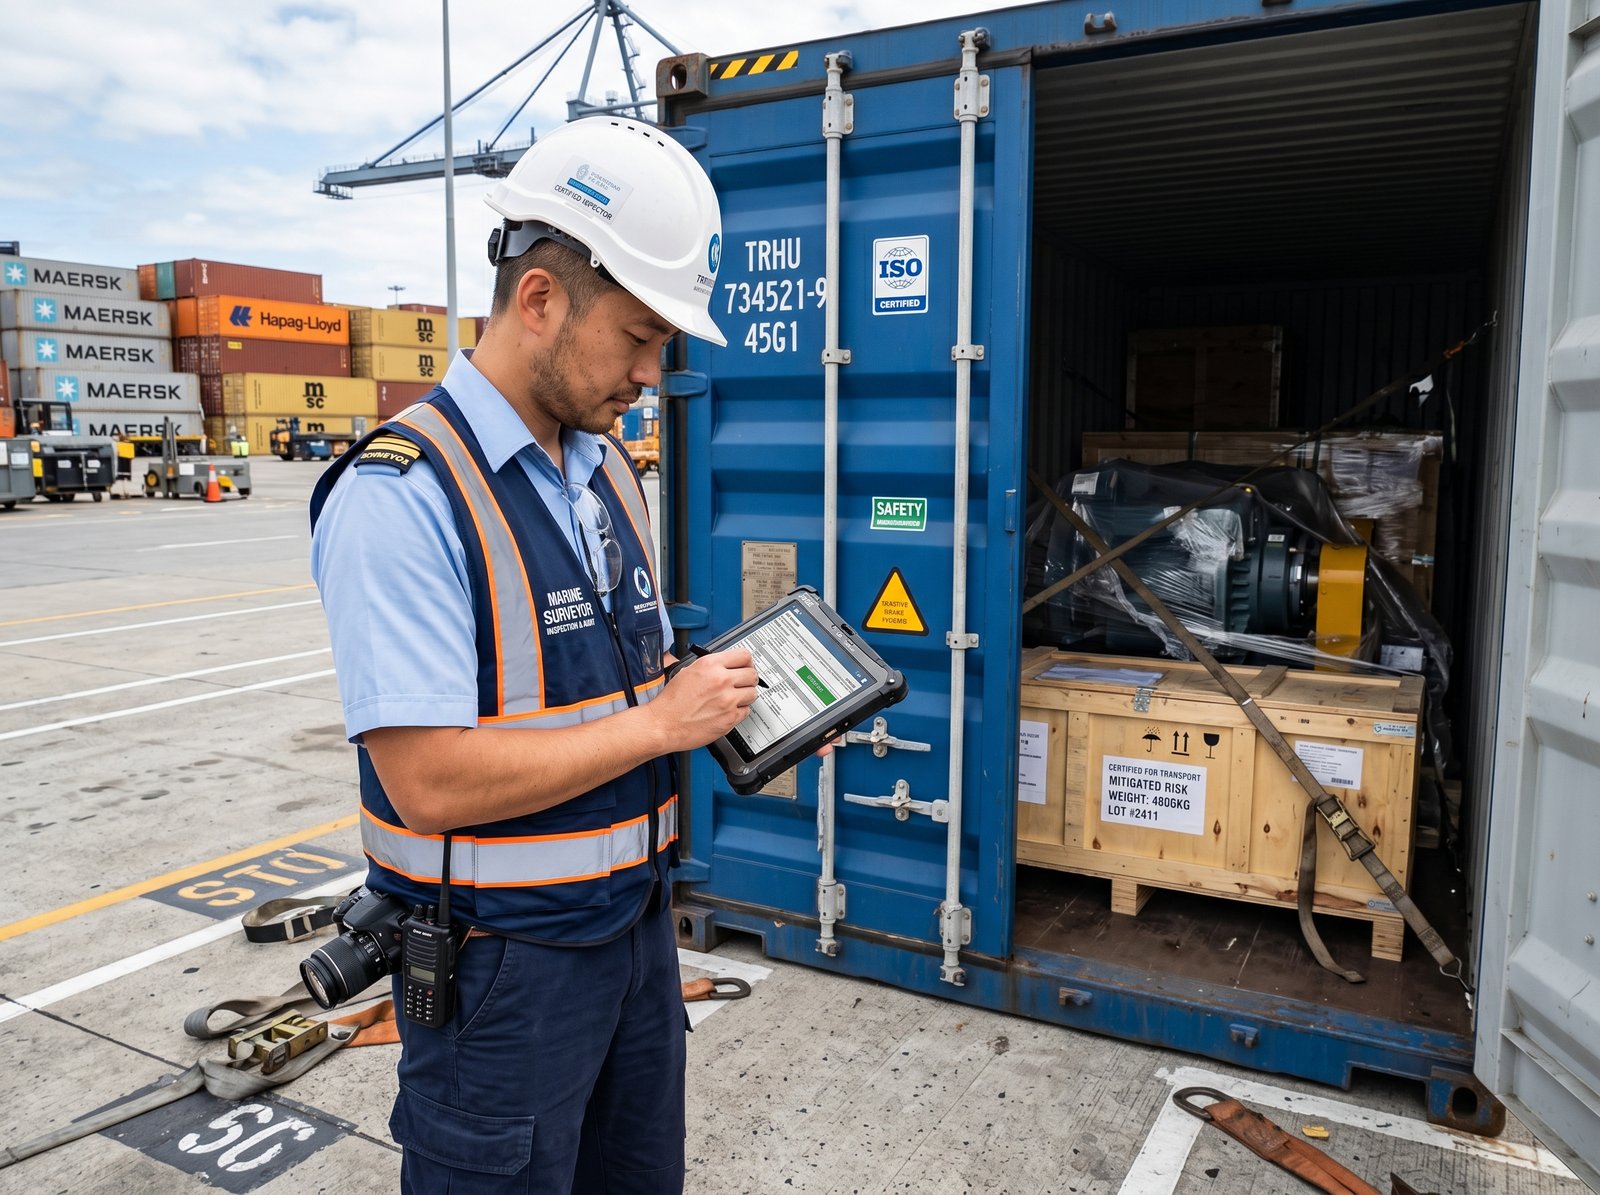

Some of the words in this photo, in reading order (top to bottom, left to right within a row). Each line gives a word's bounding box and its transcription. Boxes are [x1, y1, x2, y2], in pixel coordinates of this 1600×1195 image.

[745, 237, 801, 272] TRHU
[879, 258, 923, 279] ISO
[34, 268, 122, 291] MAERSK
[724, 277, 827, 314] 734521-9
[880, 299, 921, 309] CERTIFIED
[64, 305, 152, 326] MAERSK
[260, 312, 341, 333] Hapag-Lloyd
[744, 320, 798, 354] 45G1
[66, 344, 154, 363] MAERSK
[87, 382, 182, 399] MAERSK
[877, 502, 923, 517] SAFETY
[547, 587, 584, 607] MARINE
[543, 602, 594, 625] SURVEYOR
[1108, 763, 1143, 775] CERTIFIED
[1144, 768, 1158, 777] FOR
[1160, 769, 1201, 782] TRANSPORT
[1109, 775, 1161, 792] MITIGATED
[1164, 782, 1188, 795] RISK
[1108, 790, 1149, 805] WEIGHT:
[1152, 797, 1191, 811] 4806KG
[1108, 805, 1126, 817] LOT
[1129, 808, 1158, 821] #2411
